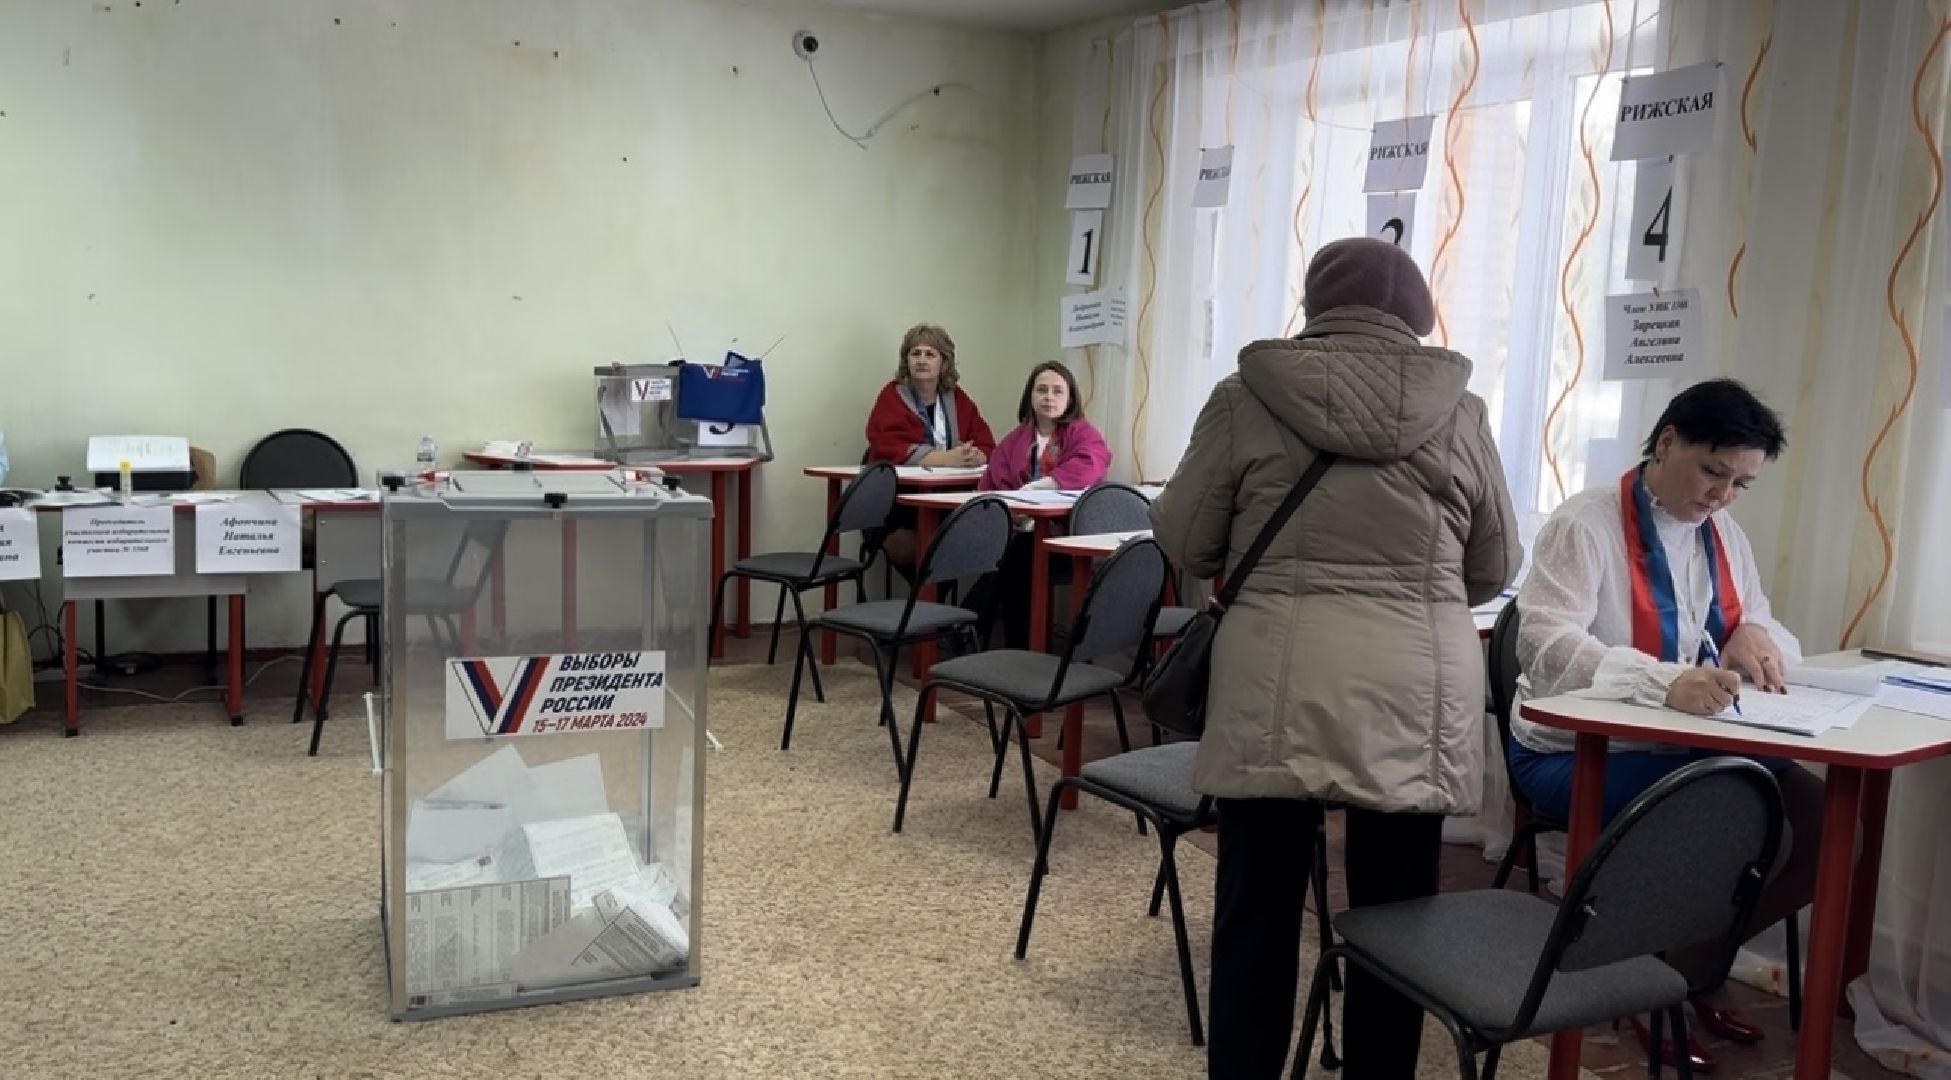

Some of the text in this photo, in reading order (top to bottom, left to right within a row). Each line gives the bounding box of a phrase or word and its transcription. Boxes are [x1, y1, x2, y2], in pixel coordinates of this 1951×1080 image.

[1620, 91, 1715, 122] РИЖСКАЯ
[1370, 141, 1430, 161] РИЖСКАЯ
[1642, 184, 1673, 263] 4
[1077, 228, 1094, 275] 1
[559, 652, 641, 672] ВЫБОРЫ
[549, 673, 664, 693] ПРЕЗИДЕНТА
[539, 695, 615, 714] РОССИИ
[571, 715, 615, 731] МАРТА
[615, 712, 648, 728] 2024
